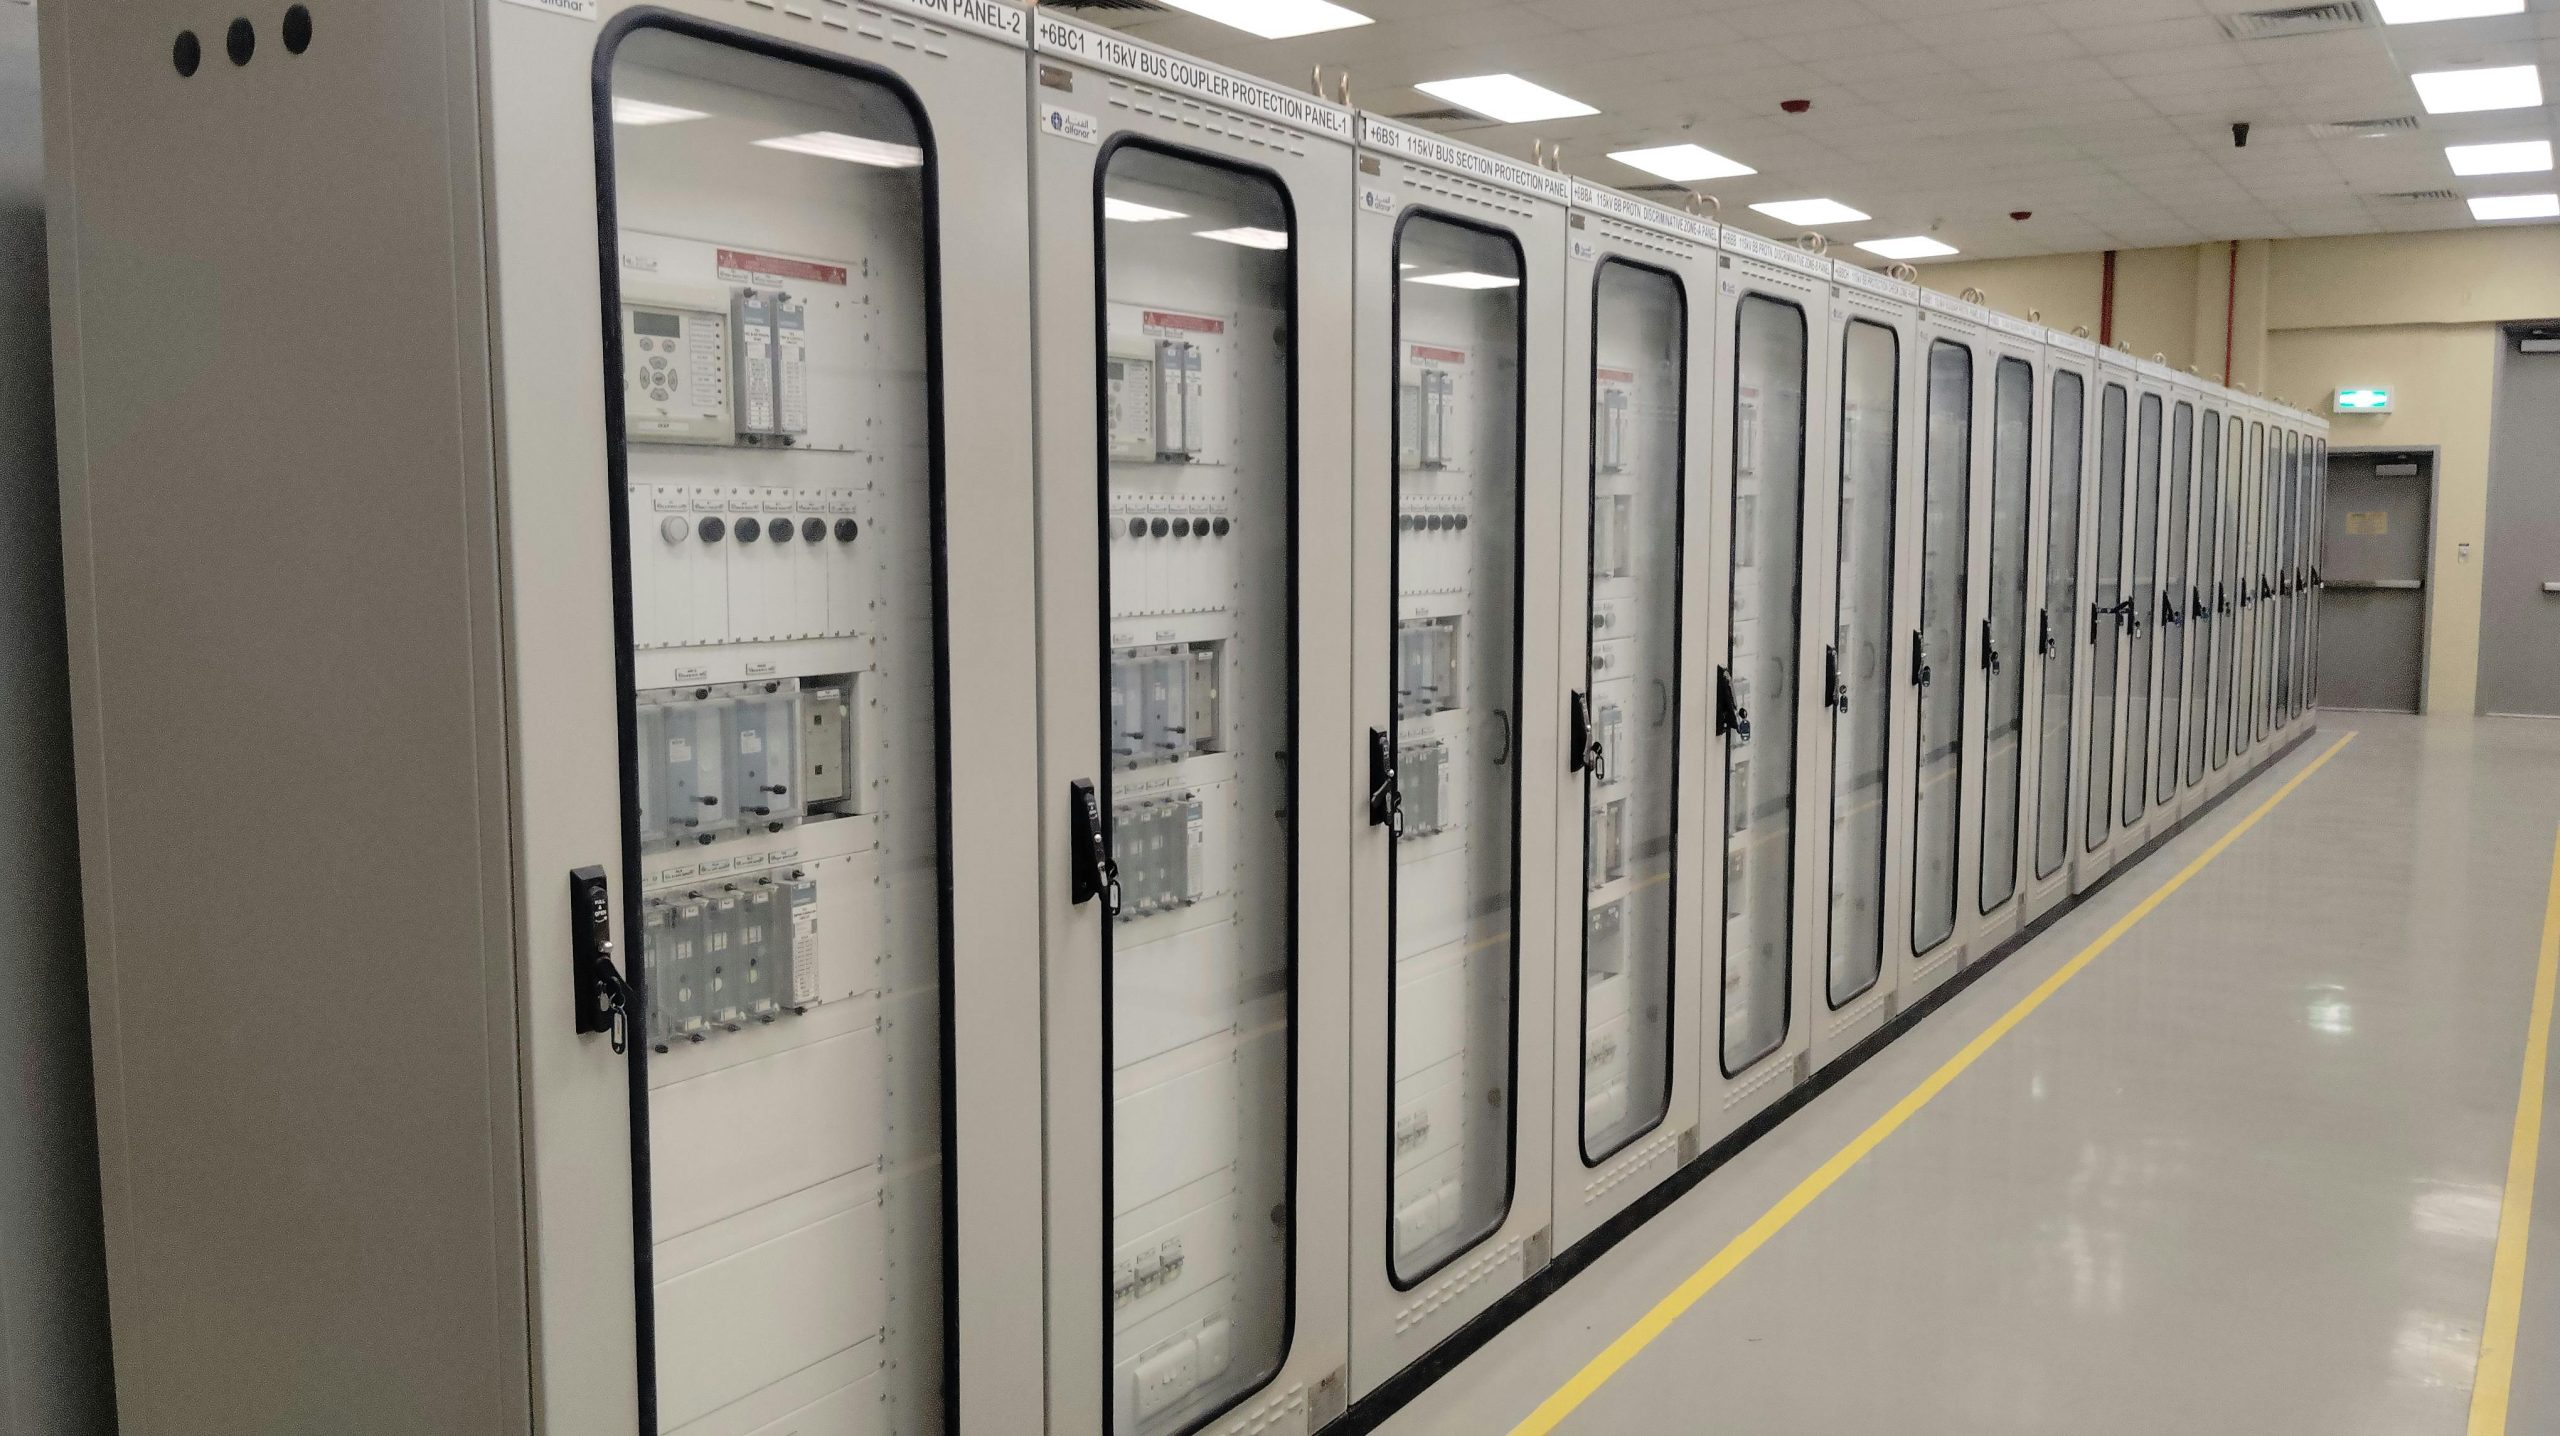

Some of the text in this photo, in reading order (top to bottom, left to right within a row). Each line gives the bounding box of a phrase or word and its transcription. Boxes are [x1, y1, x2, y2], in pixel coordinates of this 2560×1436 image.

[1040, 23, 1346, 134] +6BC1 115kV BUS COUPLER PROTECTION PANEL-1
[1064, 125, 1090, 139] alfanar
[1371, 126, 1568, 198] +6BS1 115kV BUS SECTION PROTECTION PANEL
